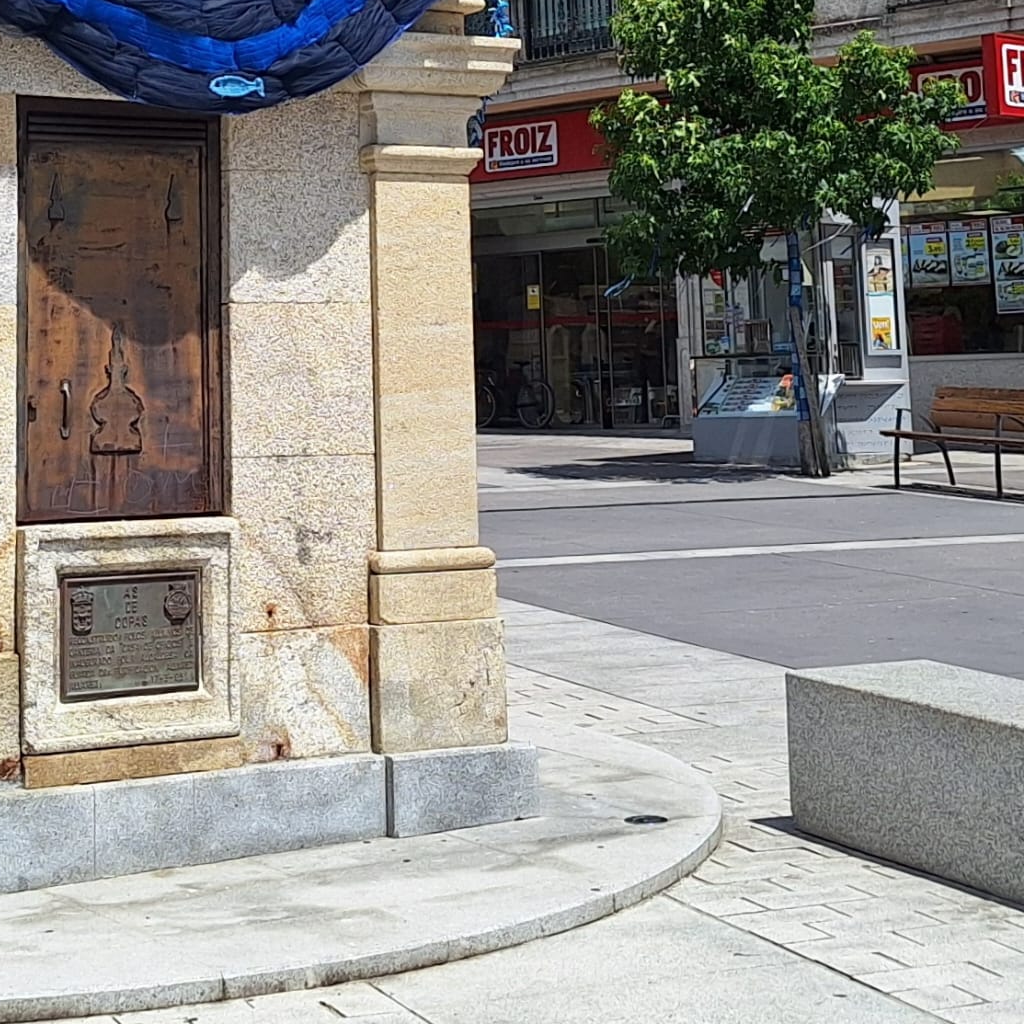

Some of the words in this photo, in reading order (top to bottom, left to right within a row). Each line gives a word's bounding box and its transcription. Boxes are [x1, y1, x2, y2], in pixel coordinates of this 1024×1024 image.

[488, 125, 552, 158] FROIZ
[123, 586, 138, 599] AS
[115, 615, 148, 629] COPAS
